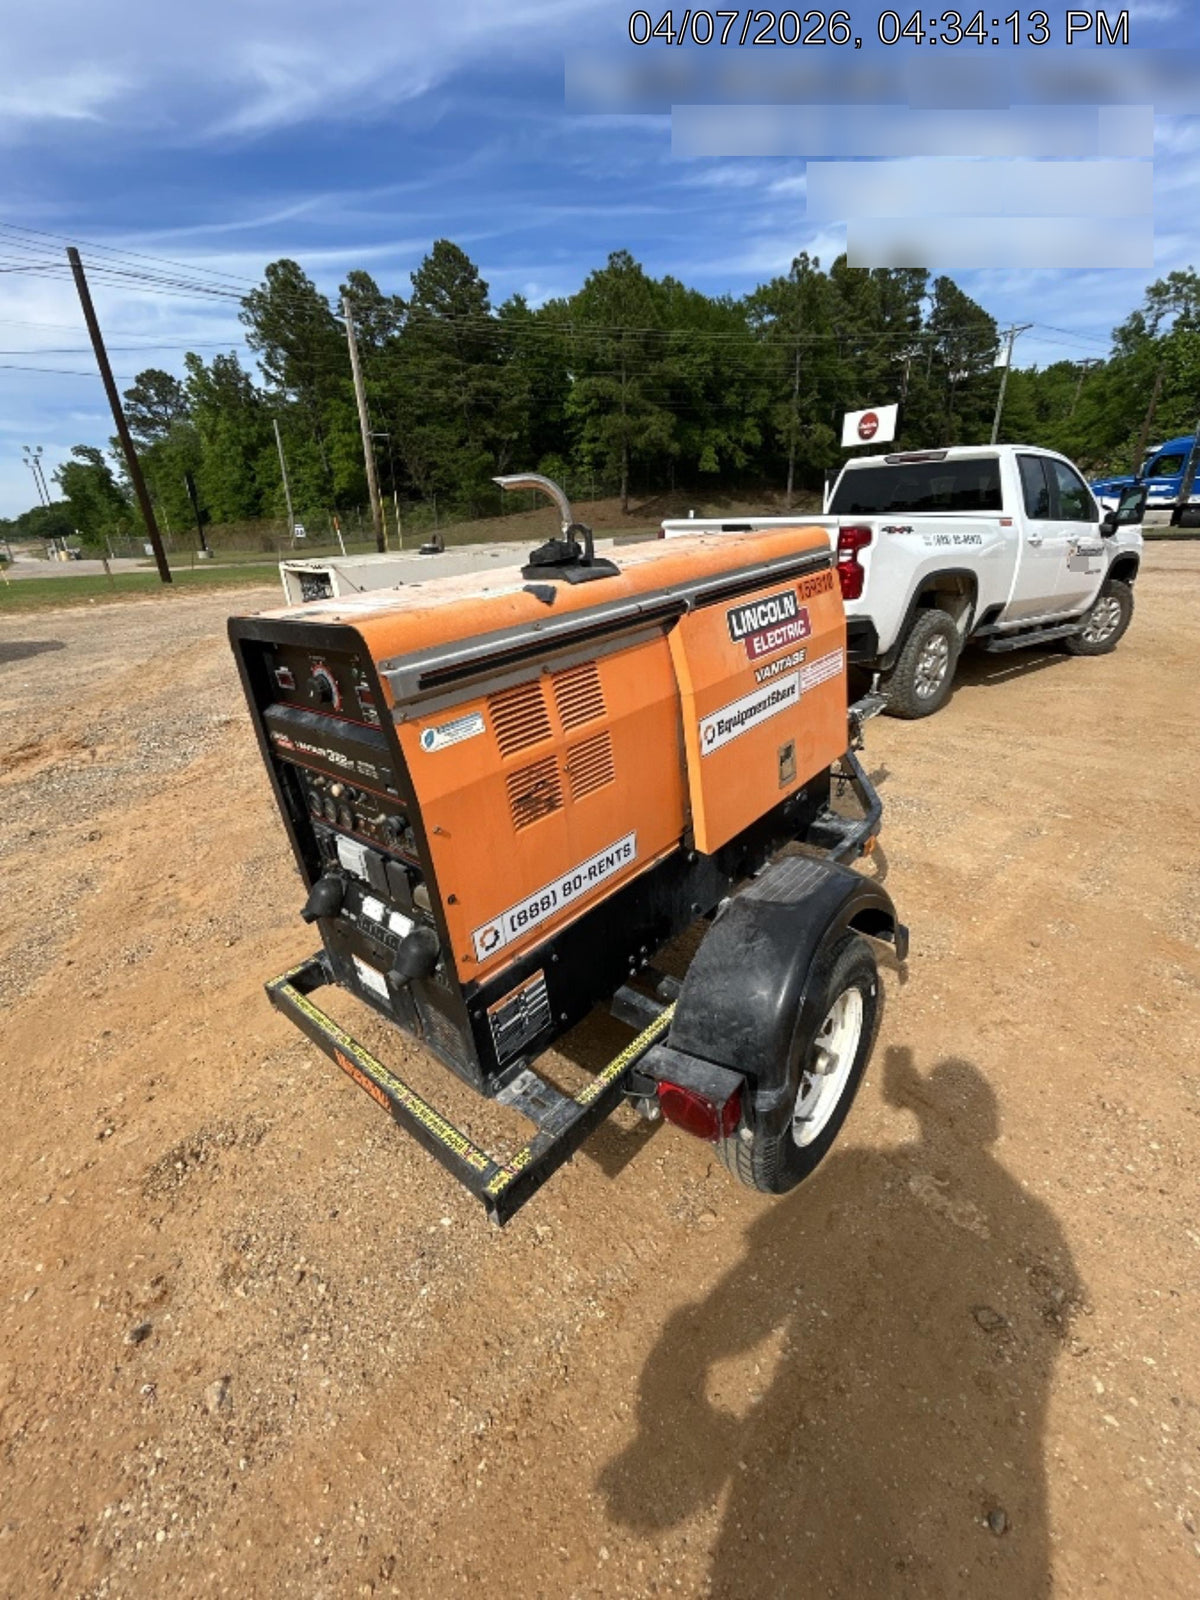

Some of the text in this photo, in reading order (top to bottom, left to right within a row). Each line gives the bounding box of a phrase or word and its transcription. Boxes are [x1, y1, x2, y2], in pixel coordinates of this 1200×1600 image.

[731, 594, 797, 637] LINCOLN
[752, 619, 806, 655] ELECTRIC
[755, 648, 807, 684] VANTAGE
[716, 682, 797, 737] EquipmentShare
[509, 843, 632, 932] (888) 80-RENTS
